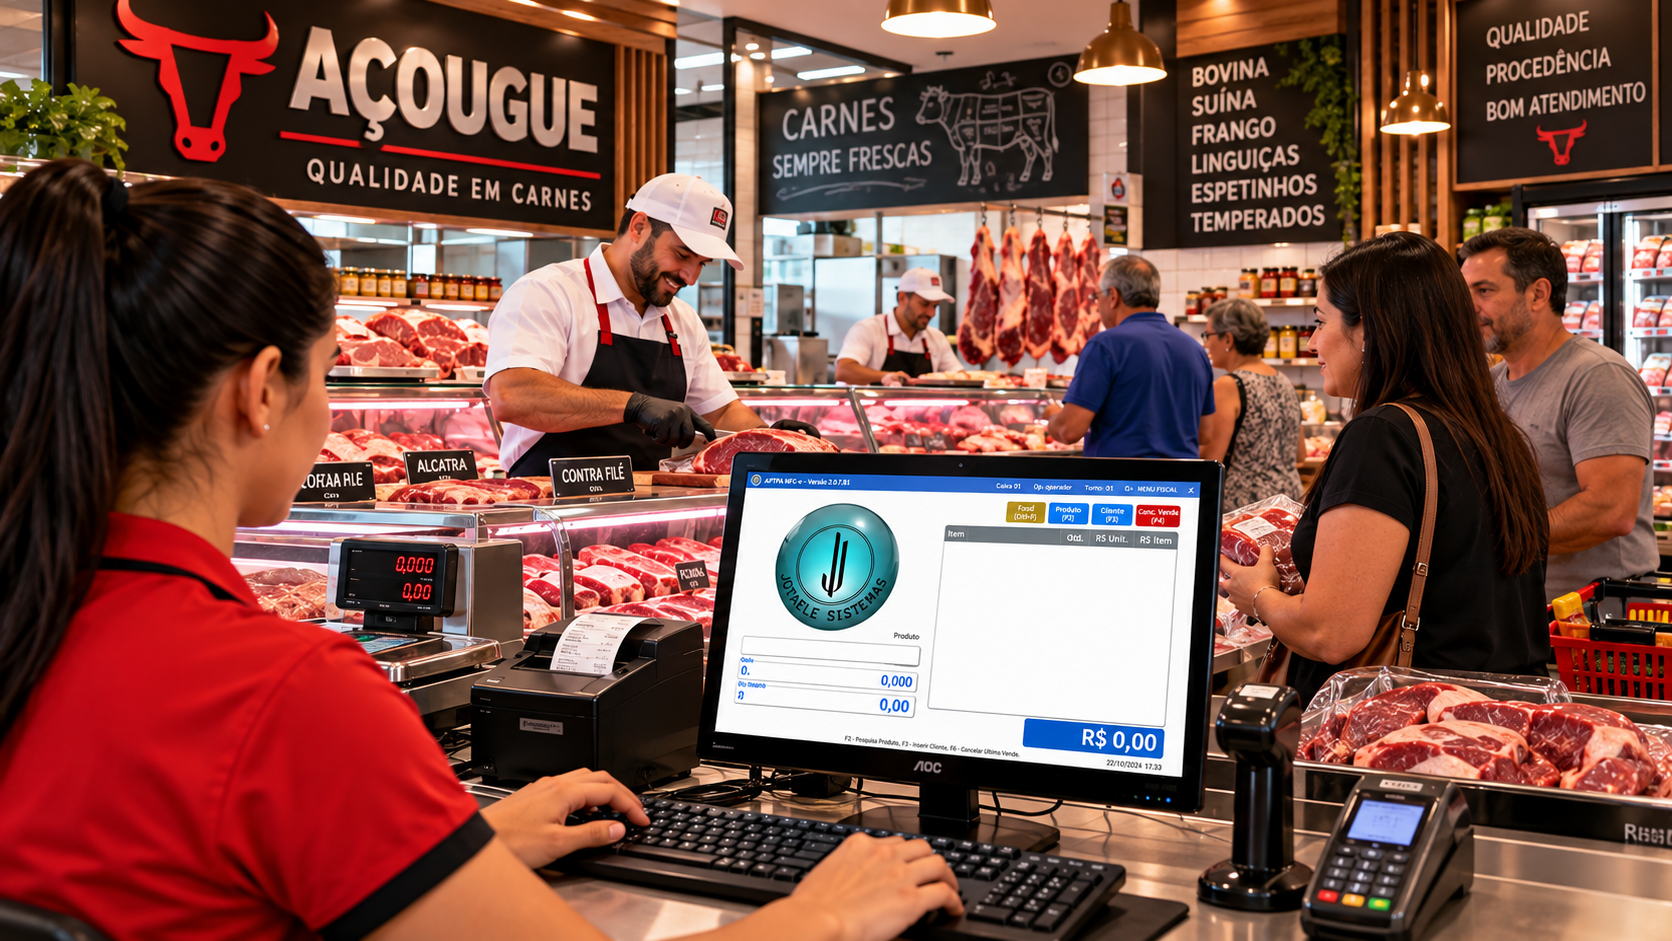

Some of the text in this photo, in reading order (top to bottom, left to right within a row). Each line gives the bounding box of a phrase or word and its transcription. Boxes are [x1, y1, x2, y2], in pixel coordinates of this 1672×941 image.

[1486, 10, 1590, 49] QUALIDADE
[1192, 57, 1269, 87] BOVINA
[1486, 47, 1611, 85] PROCEDÊNCIA
[289, 26, 598, 153] AÇOUGUE
[1192, 88, 1257, 117] SUÍNA
[1486, 81, 1646, 122] BOM ATENDIMENTO
[782, 97, 895, 141] CARNES
[1192, 116, 1276, 146] FRANGO
[772, 140, 932, 179] SEMPRE FRESCAS
[1192, 144, 1300, 175] LINGUIÇAS
[306, 158, 592, 212] QUALIDADE EM CARNES
[1191, 173, 1317, 204] ESPETINHOS
[1191, 204, 1325, 233] TEMPERADOS
[417, 458, 468, 473] ALCATRA
[562, 462, 625, 483] CONTRA FILÉ
[948, 530, 965, 538] Item
[1109, 535, 1128, 543] Unit.
[1154, 536, 1172, 545] Item
[395, 556, 434, 574] 0,000
[402, 583, 432, 601] 0,00
[781, 574, 887, 621] JOTAELE SISTEMAS
[893, 632, 920, 641] Produto
[881, 674, 912, 689] 0,000
[879, 698, 910, 714] 0,00
[1082, 727, 1157, 753] R$ 0,00
[913, 760, 942, 774] AOC
[1106, 759, 1142, 769] 22/10/2024
